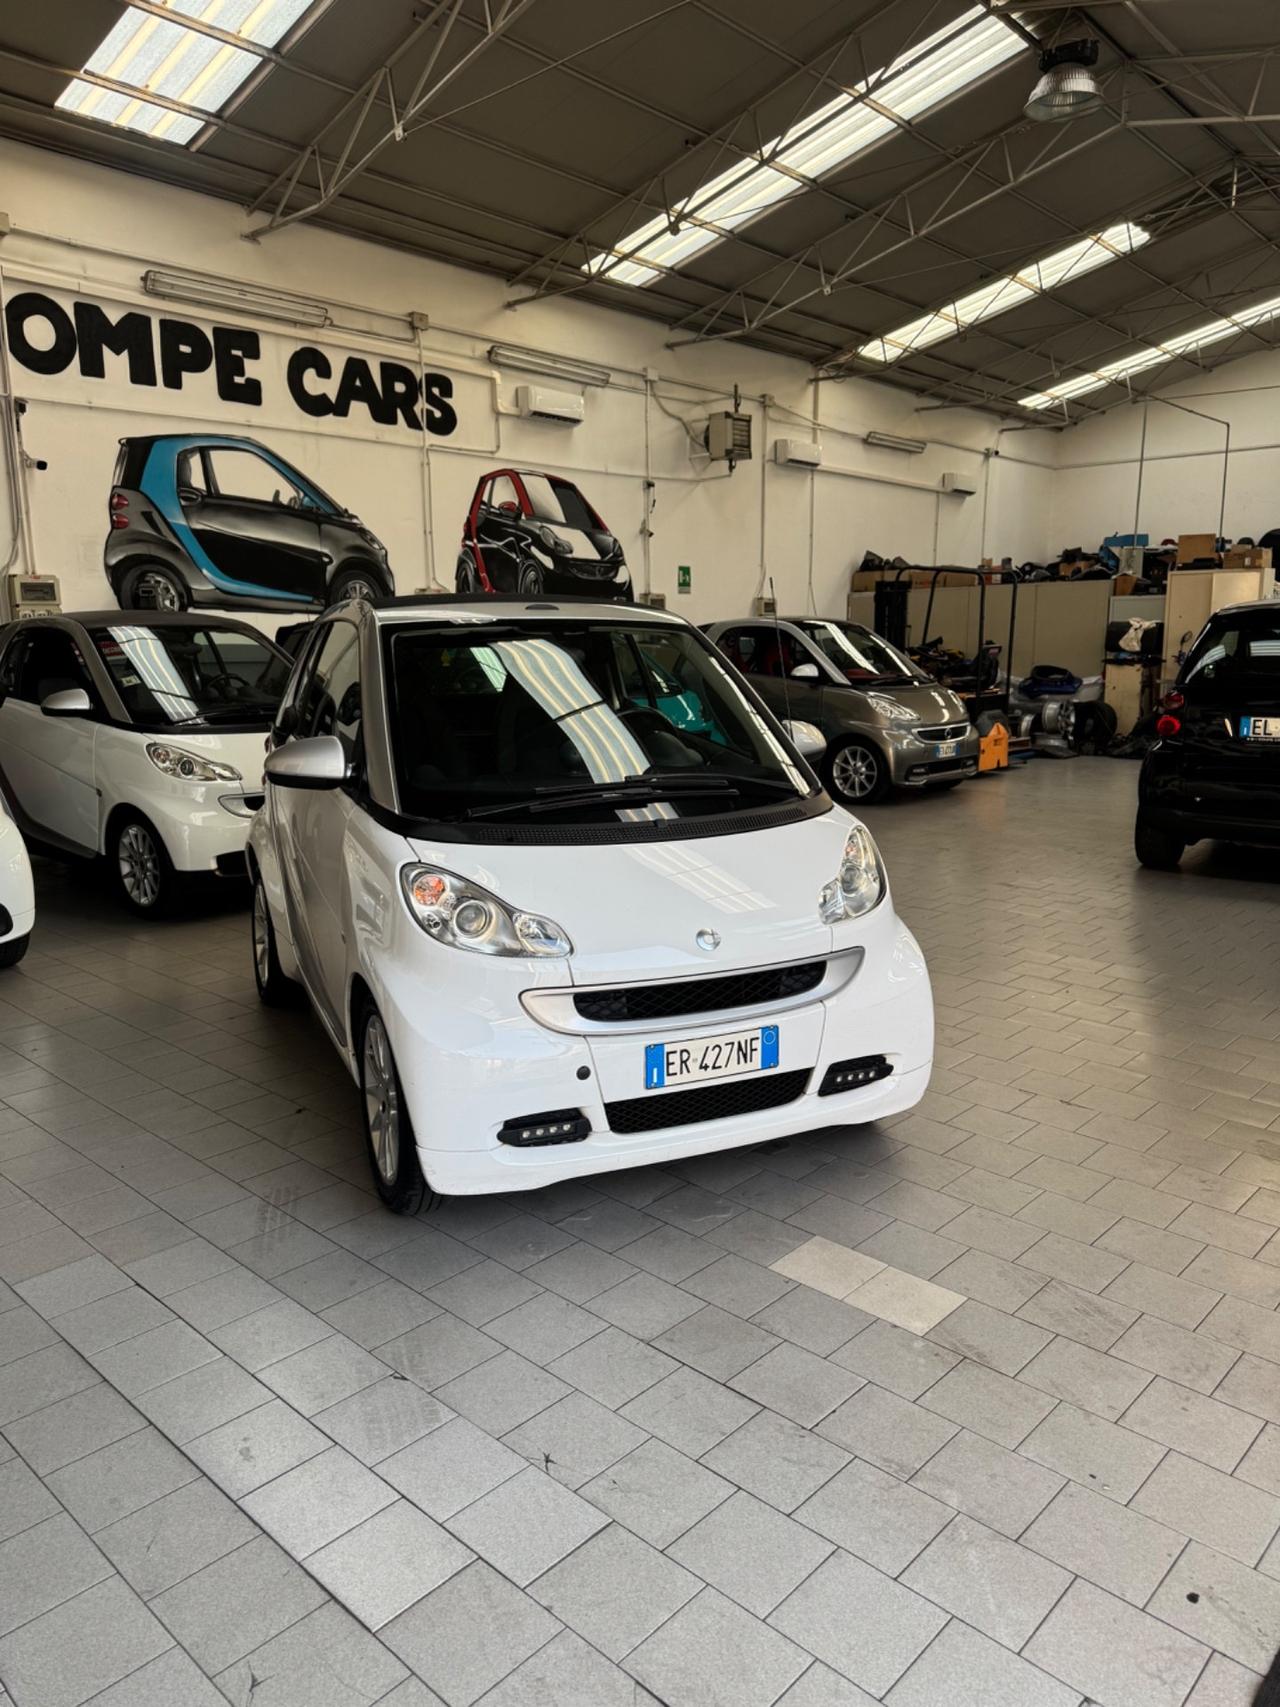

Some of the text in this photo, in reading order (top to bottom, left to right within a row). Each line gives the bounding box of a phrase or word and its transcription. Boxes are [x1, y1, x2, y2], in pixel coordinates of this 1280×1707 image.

[5, 292, 458, 436] OMPE CARS
[666, 1049, 691, 1077] ER
